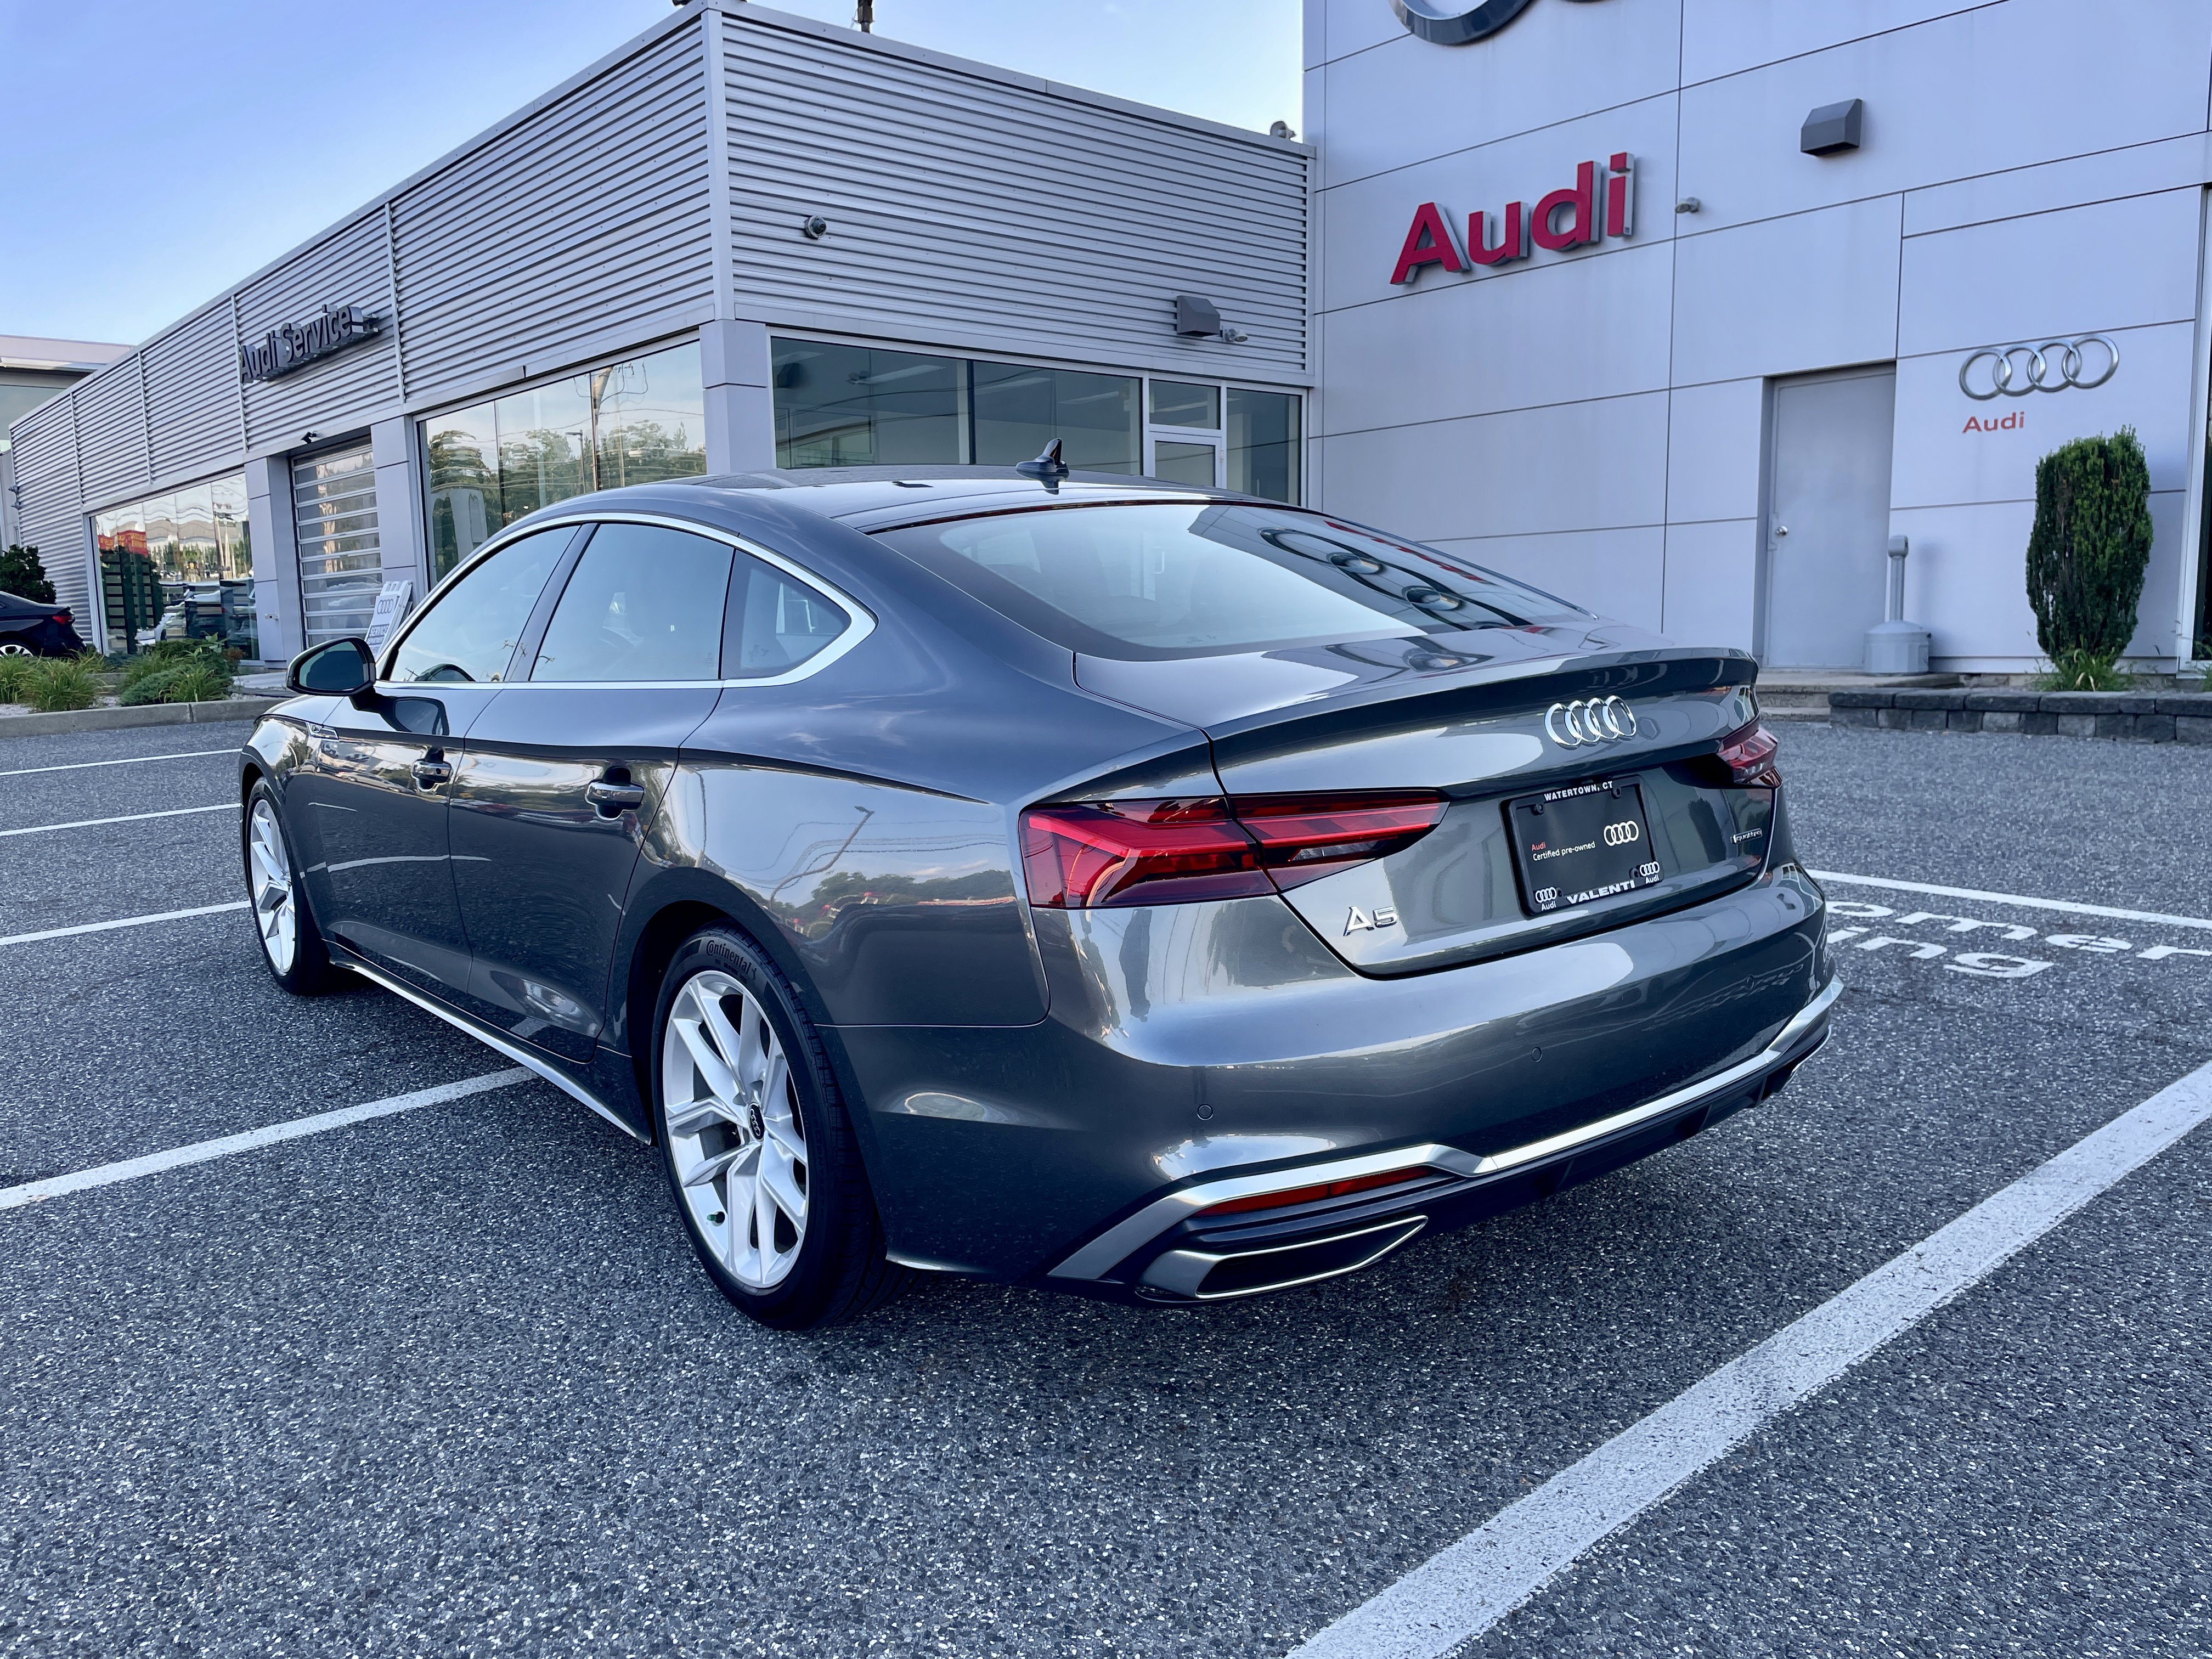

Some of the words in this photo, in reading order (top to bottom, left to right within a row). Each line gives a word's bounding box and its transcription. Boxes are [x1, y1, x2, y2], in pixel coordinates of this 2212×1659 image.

[1389, 151, 1634, 285] Audi
[239, 329, 282, 383] Audi
[280, 304, 362, 364] Service
[1962, 411, 2025, 433] Audi
[369, 625, 388, 636] SERVICE
[1544, 785, 1600, 801] WATERTOWN,
[1602, 781, 1613, 789] CT
[1531, 842, 1546, 851] Audi
[1533, 849, 1560, 861] Certified
[1561, 840, 1595, 856] pre-owned
[1645, 875, 1659, 884] Audi
[1566, 879, 1635, 904] VALENTI
[1541, 900, 1556, 911] Audi
[1343, 906, 1398, 936] A5
[706, 940, 752, 975] Continental
